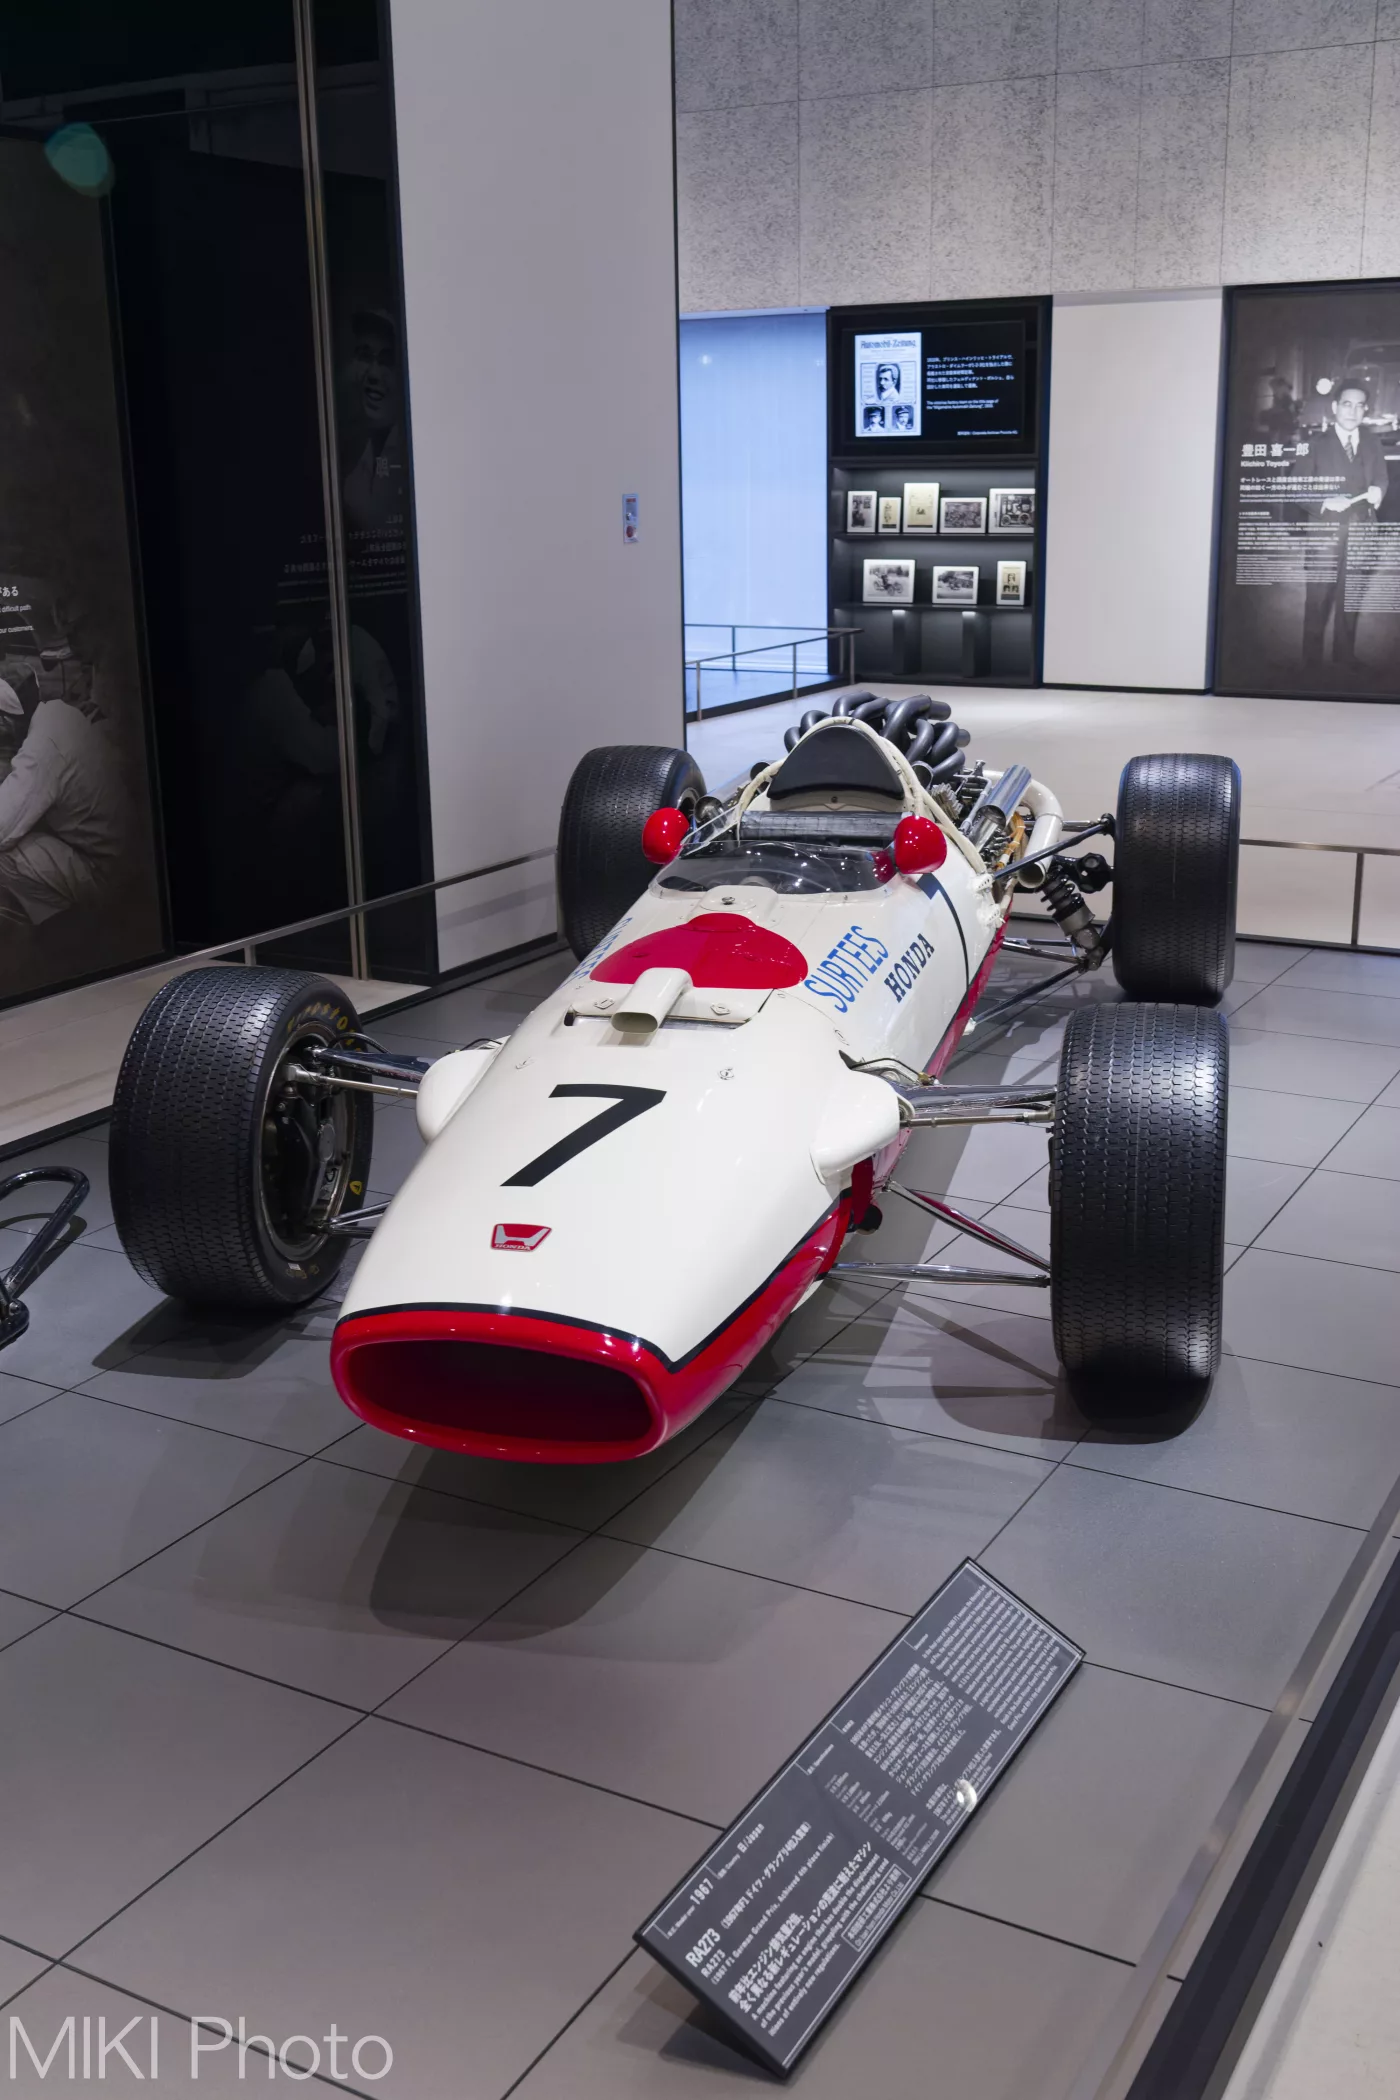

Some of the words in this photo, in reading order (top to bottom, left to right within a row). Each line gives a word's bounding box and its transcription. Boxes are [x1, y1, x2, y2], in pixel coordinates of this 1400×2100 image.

[804, 925, 889, 1013] SURTEES
[884, 933, 935, 1003] HONDA
[500, 1083, 667, 1187] 7
[494, 1243, 532, 1251] HONDA
[735, 1820, 766, 1854] 日/Japan
[852, 1852, 881, 1888] displacement
[688, 1876, 716, 1906] 1967
[831, 1894, 849, 1916] double
[845, 1885, 856, 1898] the
[709, 1963, 729, 1986] (1967
[723, 1955, 736, 1968] F1
[730, 1931, 754, 1959] German
[749, 1913, 769, 1935] Grand
[776, 1874, 801, 1903] Achieved
[796, 1864, 809, 1878] 4th
[804, 1849, 821, 1868] place
[816, 1831, 836, 1853] finish)
[823, 1912, 835, 1925] has
[853, 1936, 863, 1947] On
[858, 1927, 869, 1940] loan
[865, 1918, 876, 1931] from
[872, 1905, 886, 1921] Honda
[881, 1894, 894, 1909] Motor
[758, 2016, 769, 2029] of
[764, 2006, 777, 2021] the
[772, 1981, 797, 2011] previous
[791, 1964, 810, 1986] year's
[804, 1945, 823, 1968] model,
[818, 1920, 843, 1950] grappling
[838, 1908, 852, 1924] with
[847, 1898, 859, 1911] the
[854, 1869, 881, 1902] challenging
[876, 1857, 890, 1873] cond
[799, 1934, 819, 1957] engine
[814, 1922, 827, 1938] that
[683, 1926, 722, 1969] RA273
[699, 1947, 726, 1978] RA273
[794, 1953, 804, 1964] an
[767, 2016, 785, 2037] itions
[781, 2008, 791, 2019] of
[786, 1985, 808, 2012] entirely
[803, 1973, 817, 1989] new
[812, 1940, 842, 1977] regulations.
[773, 1960, 799, 1991] featuring
[750, 2012, 759, 2021] A
[754, 1987, 778, 2015] machine
